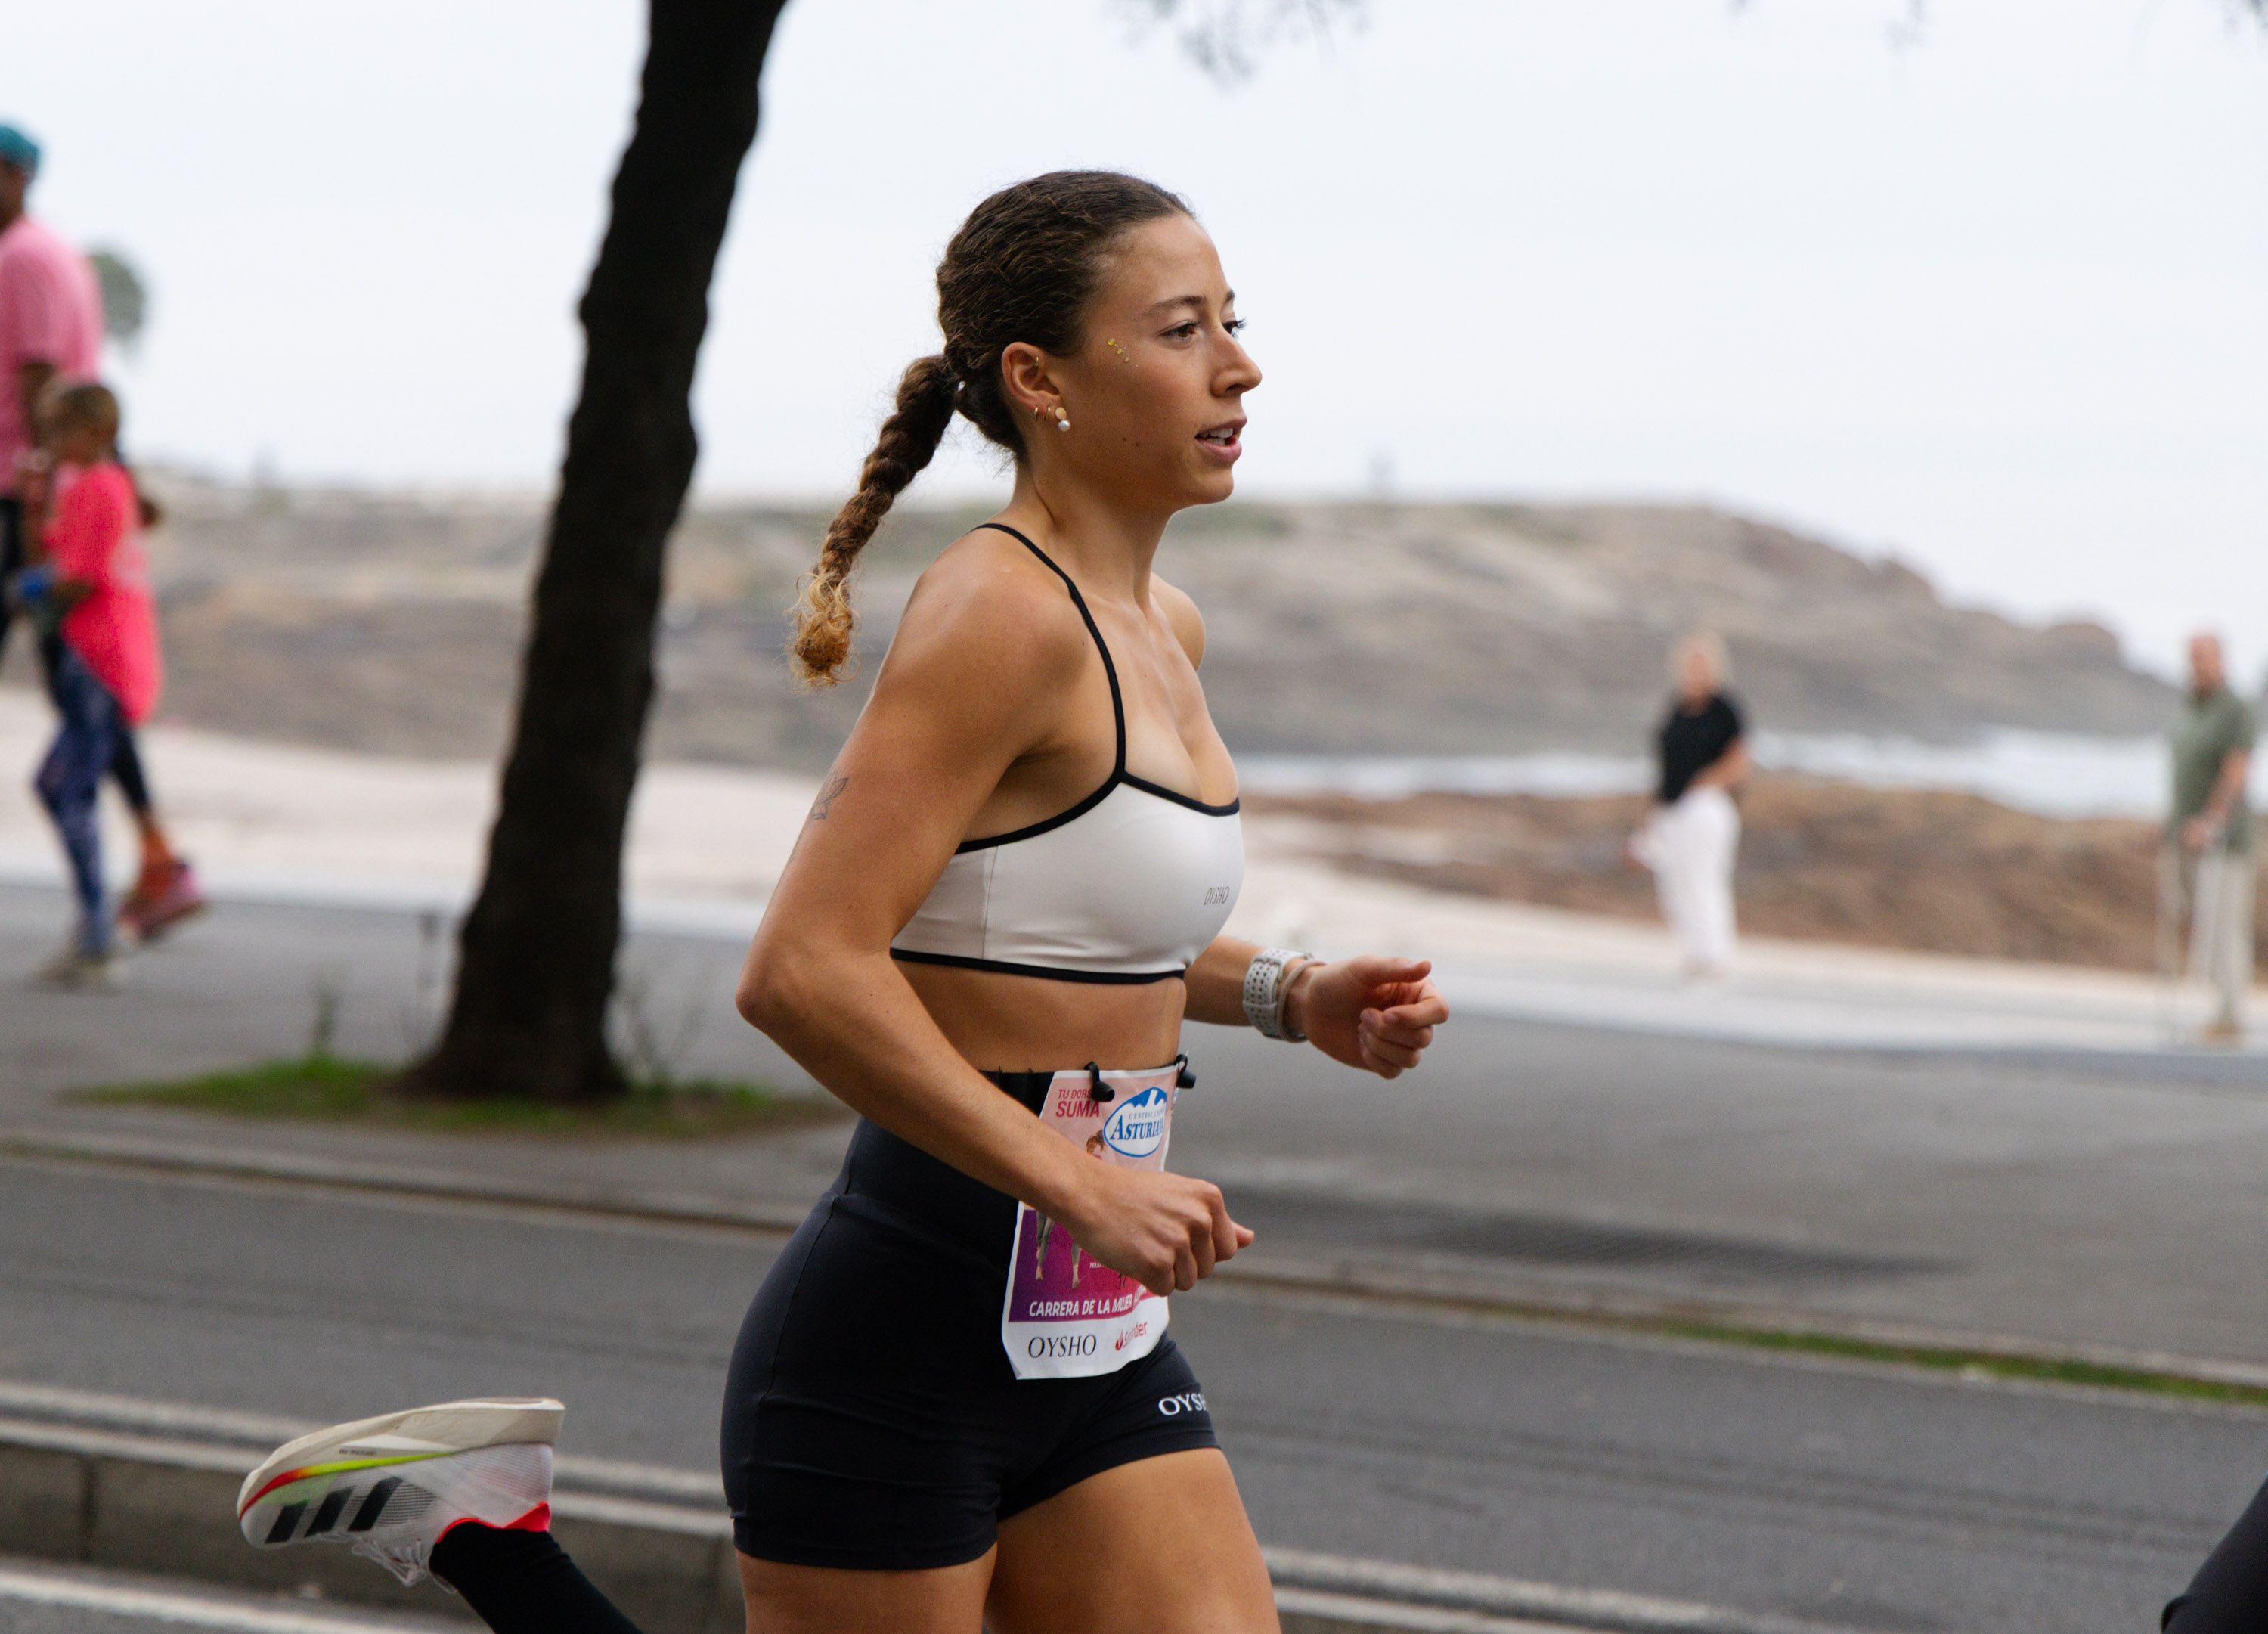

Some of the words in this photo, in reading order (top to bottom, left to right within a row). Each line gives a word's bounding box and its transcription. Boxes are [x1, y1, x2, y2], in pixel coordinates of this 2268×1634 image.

[1058, 1089, 1070, 1099] TU
[1071, 1089, 1092, 1099] DORS
[1055, 1100, 1100, 1118] SUMA
[1029, 1301, 1079, 1316] CARRERA
[1081, 1301, 1094, 1316] DE
[1098, 1299, 1110, 1315] LA
[1111, 1294, 1132, 1313] MUJER
[1027, 1335, 1096, 1359] OYSHO
